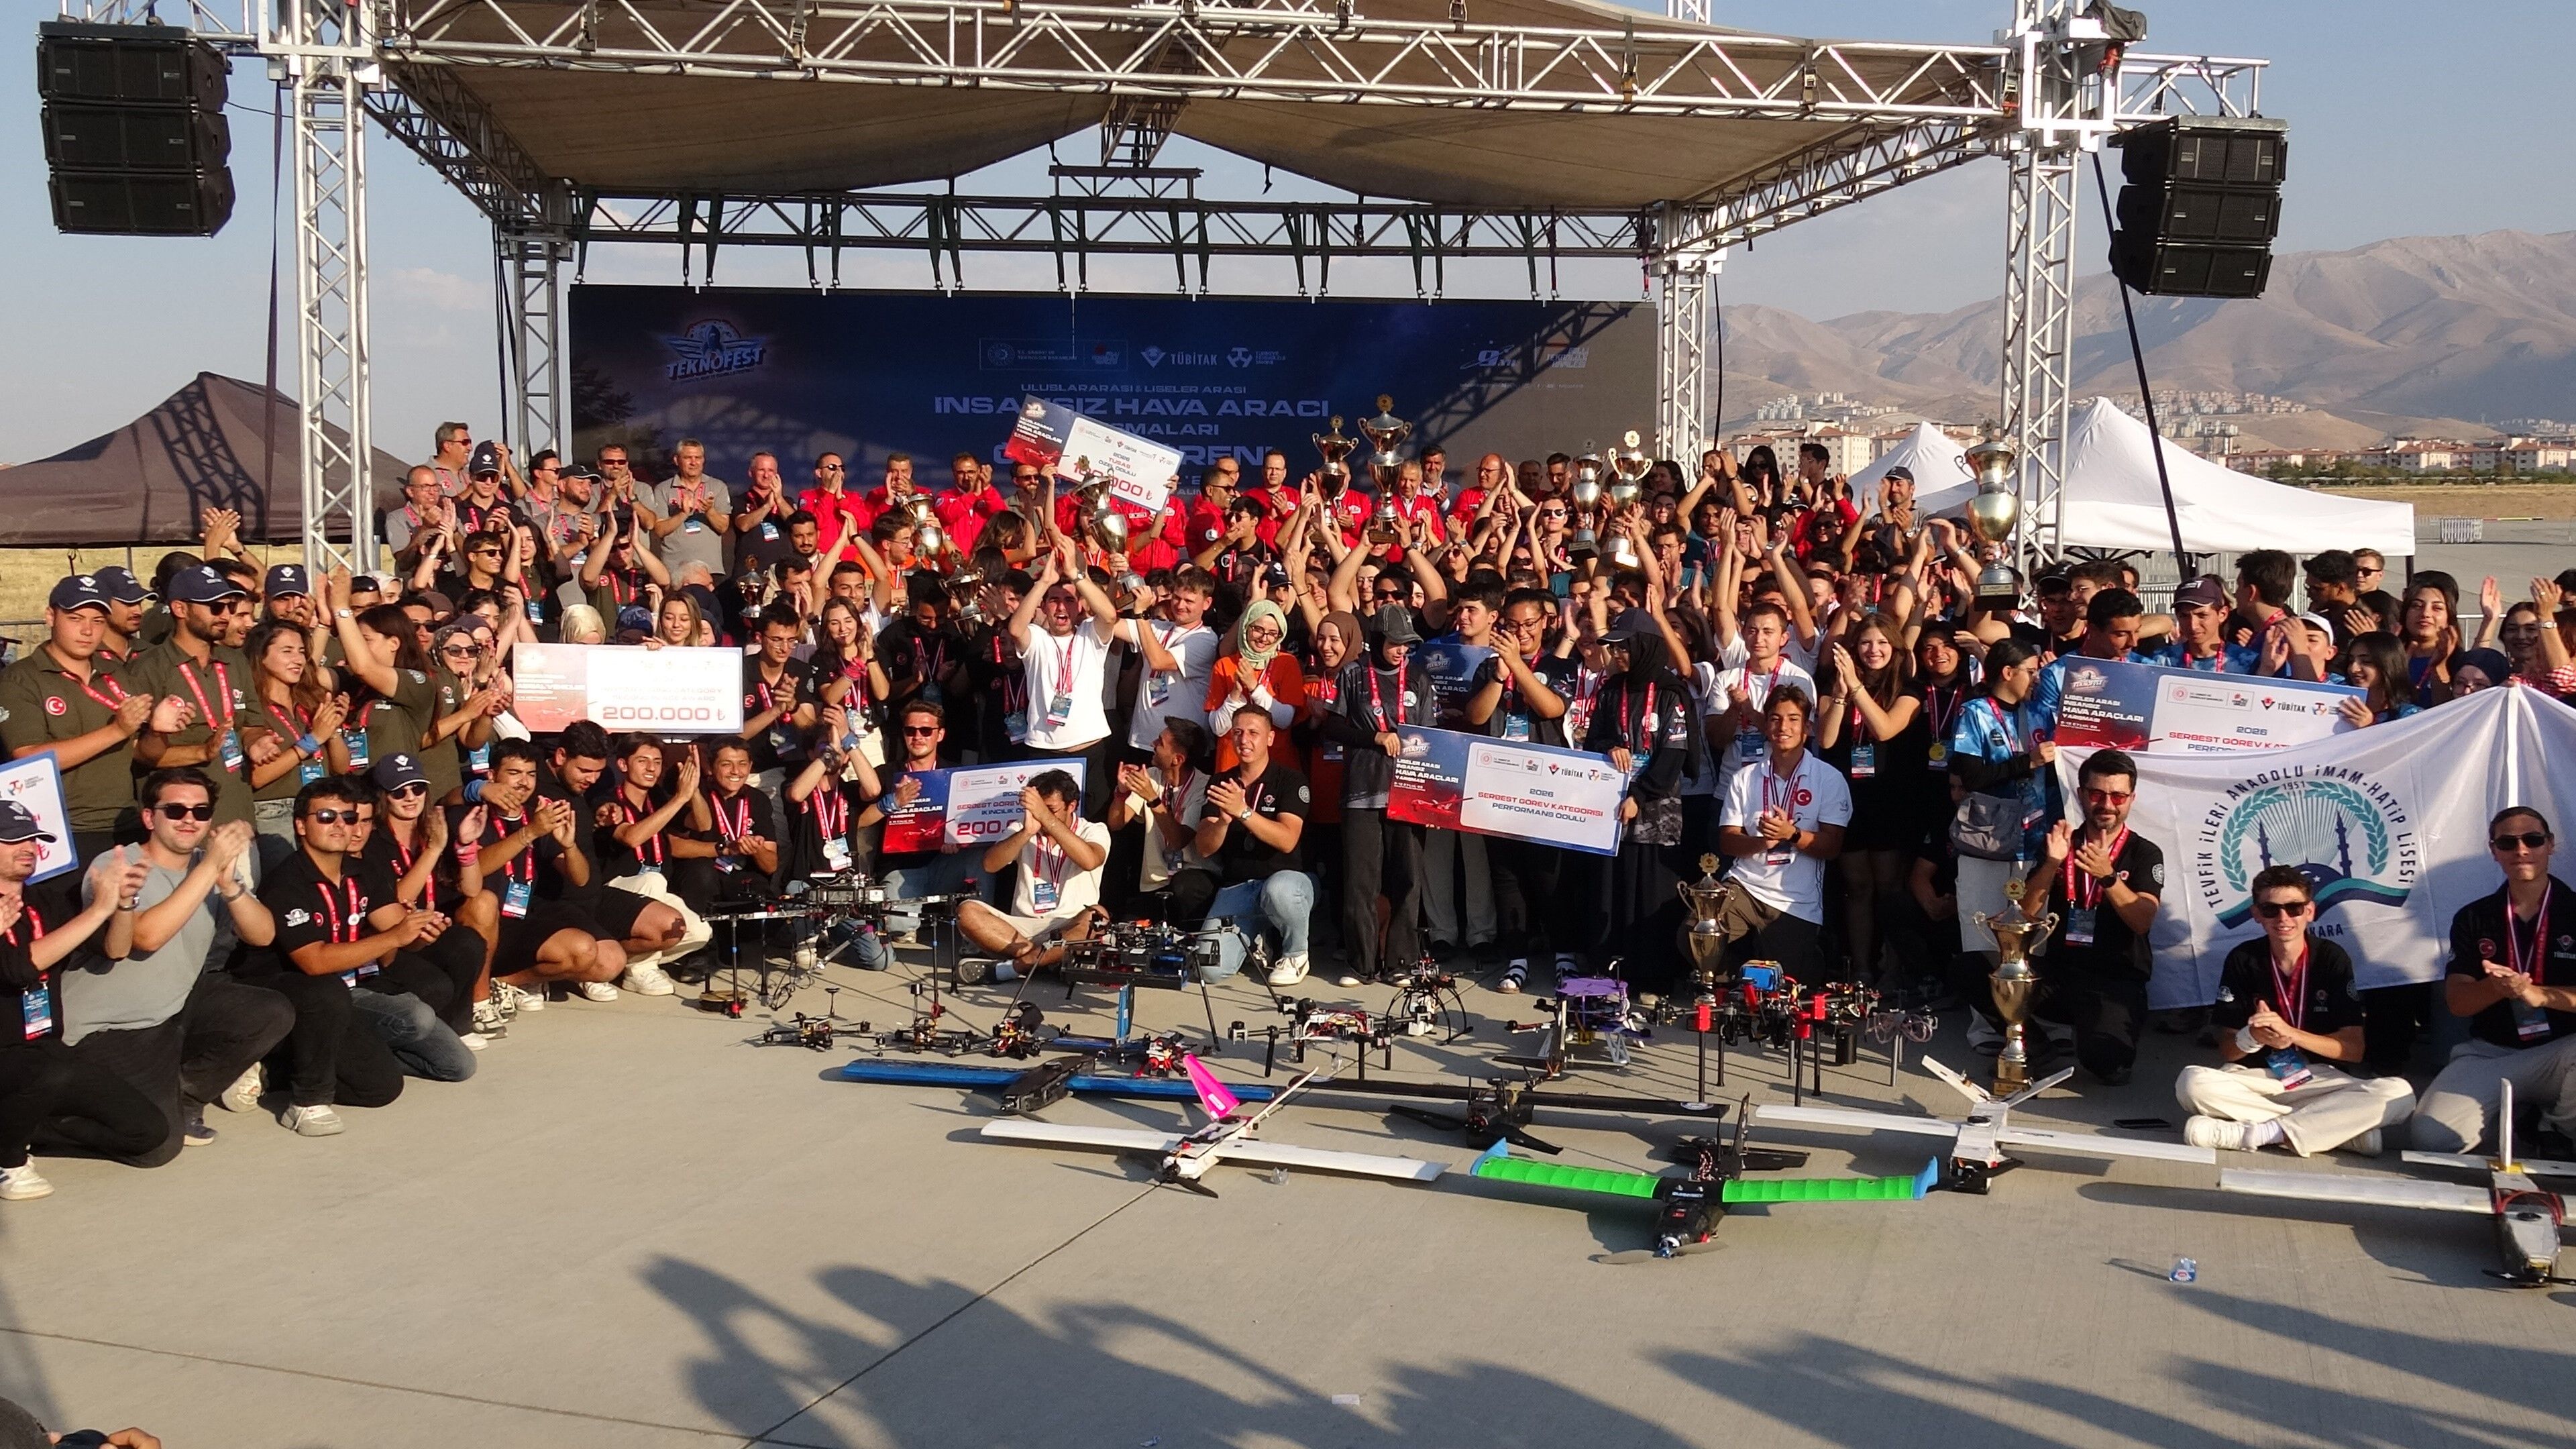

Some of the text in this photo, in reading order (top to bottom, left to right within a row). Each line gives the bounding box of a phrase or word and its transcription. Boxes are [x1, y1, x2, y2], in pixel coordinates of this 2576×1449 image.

[667, 348, 765, 380] TEKNOFEST
[1170, 352, 1218, 365] TÜBİTAK
[1201, 386, 1246, 394] ARASI
[1114, 398, 1209, 416] HAVA
[1215, 400, 1328, 417] ARACI
[2063, 706, 2090, 715] HAVA
[2277, 702, 2306, 712] TÜBİTAK
[602, 706, 710, 721] 200.000
[2237, 726, 2267, 735] 2026
[2169, 731, 2220, 743] SERBEST
[1395, 768, 1416, 777] HAVA
[1561, 767, 1584, 779] TÜBİTAK
[2226, 765, 2304, 801] ANADOLU
[2282, 781, 2306, 790] 1951
[1478, 792, 1517, 803] SERBEST
[1529, 788, 1554, 798] 2026
[1492, 802, 1554, 818] PERFORMANS
[2308, 924, 2344, 939] KARA
